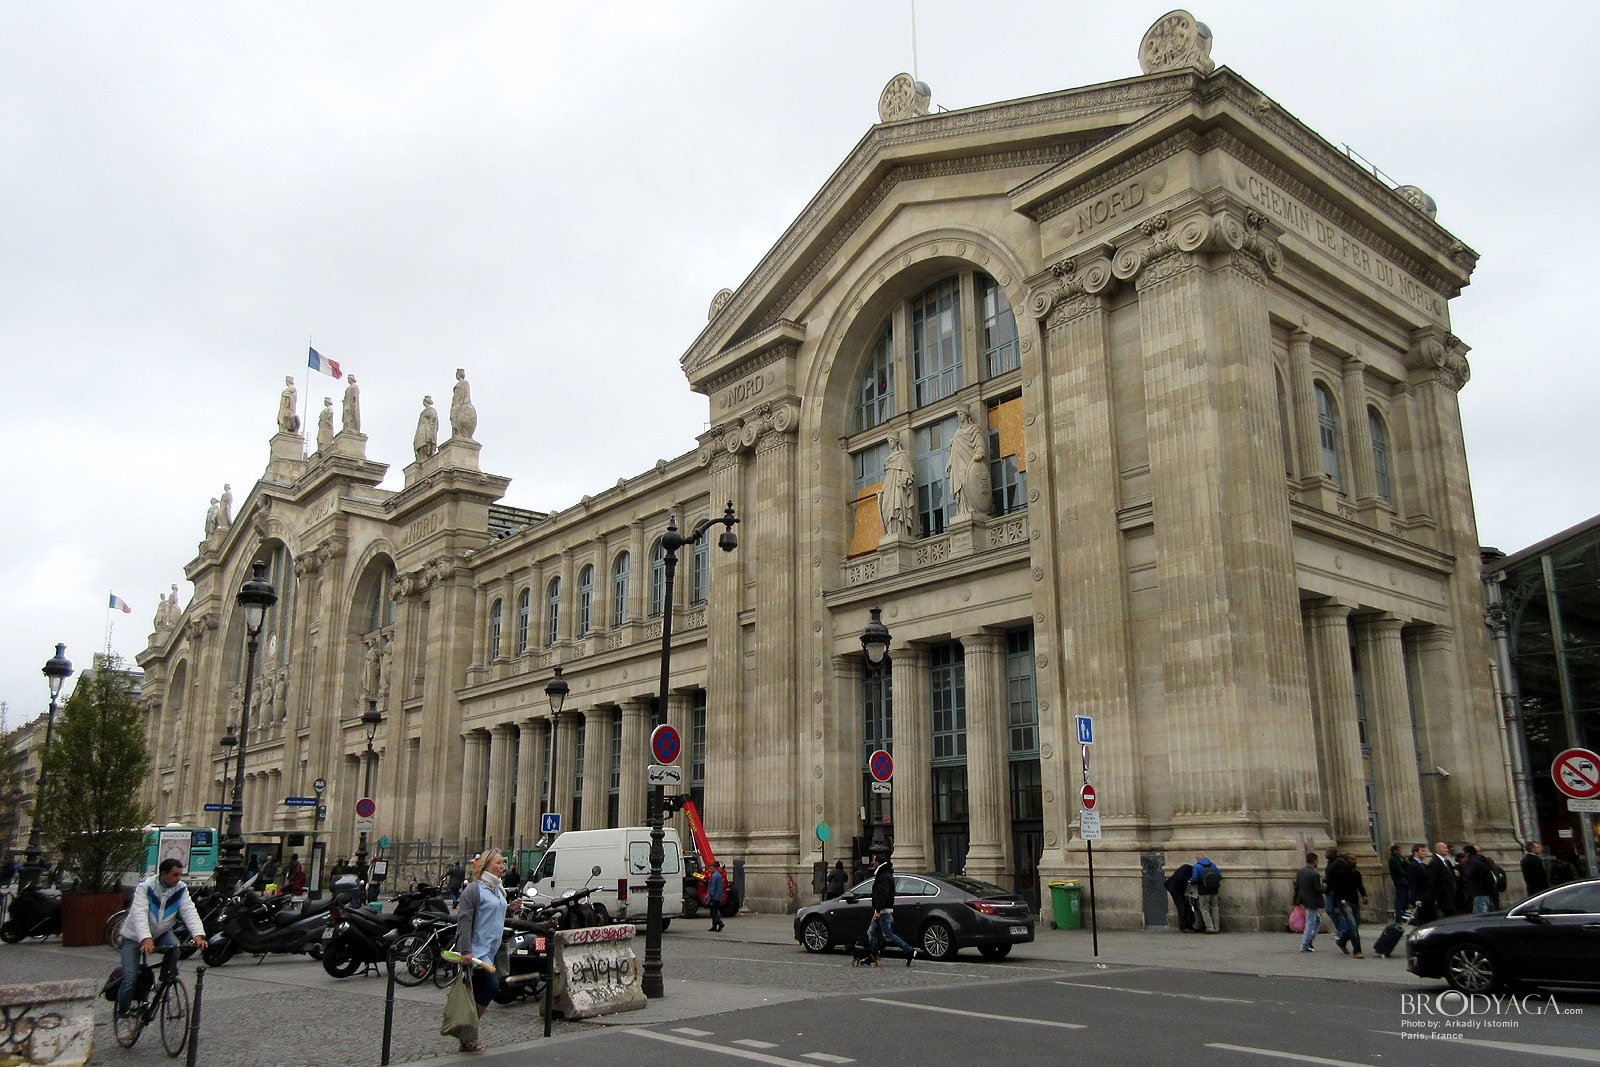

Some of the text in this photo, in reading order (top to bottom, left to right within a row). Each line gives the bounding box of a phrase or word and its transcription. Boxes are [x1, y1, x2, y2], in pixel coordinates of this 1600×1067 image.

[1077, 182, 1145, 235] NORD
[1248, 175, 1433, 312] CHEMIN DE FER DU NORD
[727, 375, 765, 408] NORD
[407, 512, 438, 545] NORD
